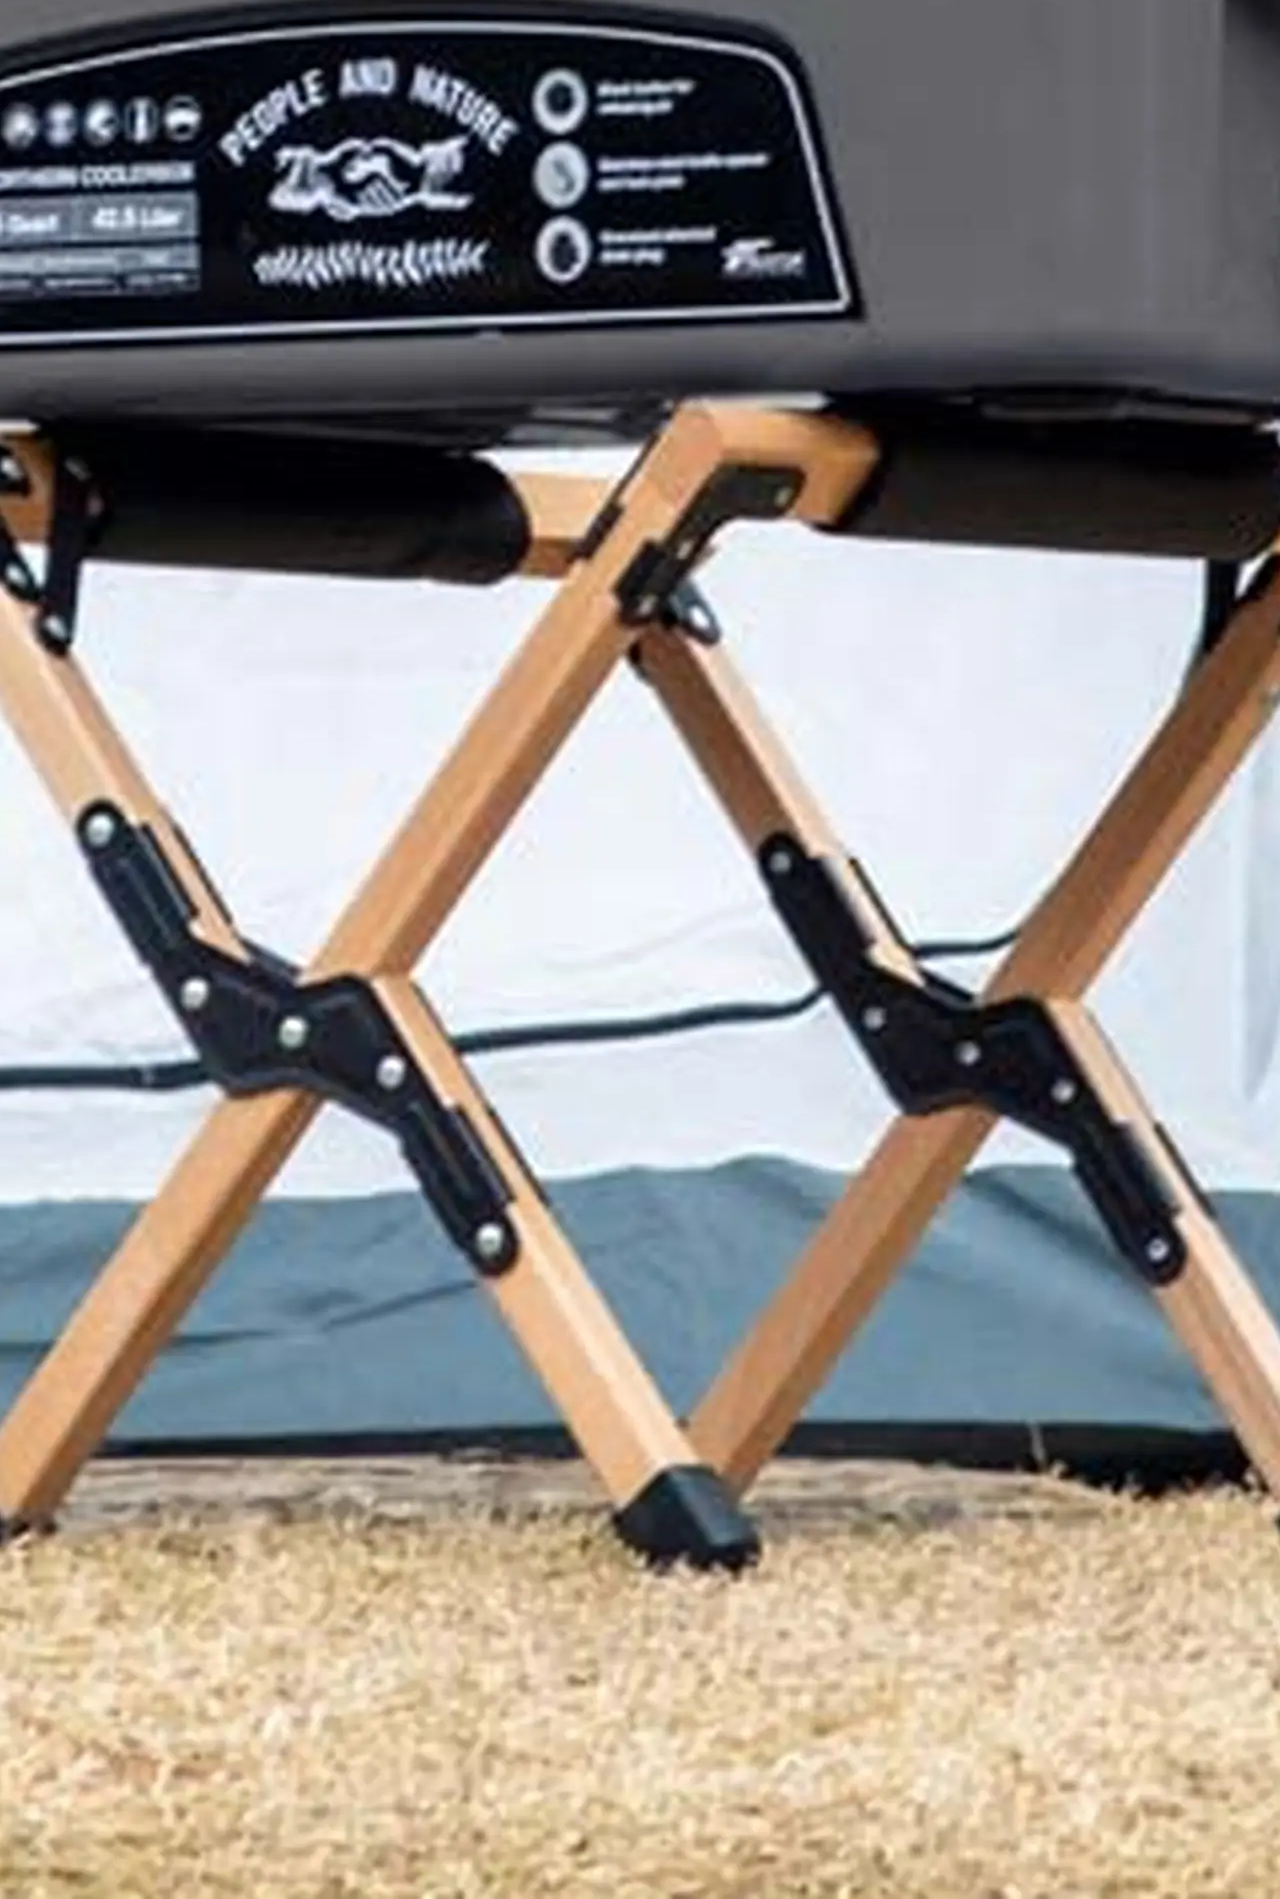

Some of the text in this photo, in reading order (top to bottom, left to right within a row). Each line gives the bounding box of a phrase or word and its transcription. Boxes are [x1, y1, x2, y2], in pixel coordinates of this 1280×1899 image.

[218, 58, 519, 166] PEOPLE AND NATURE
